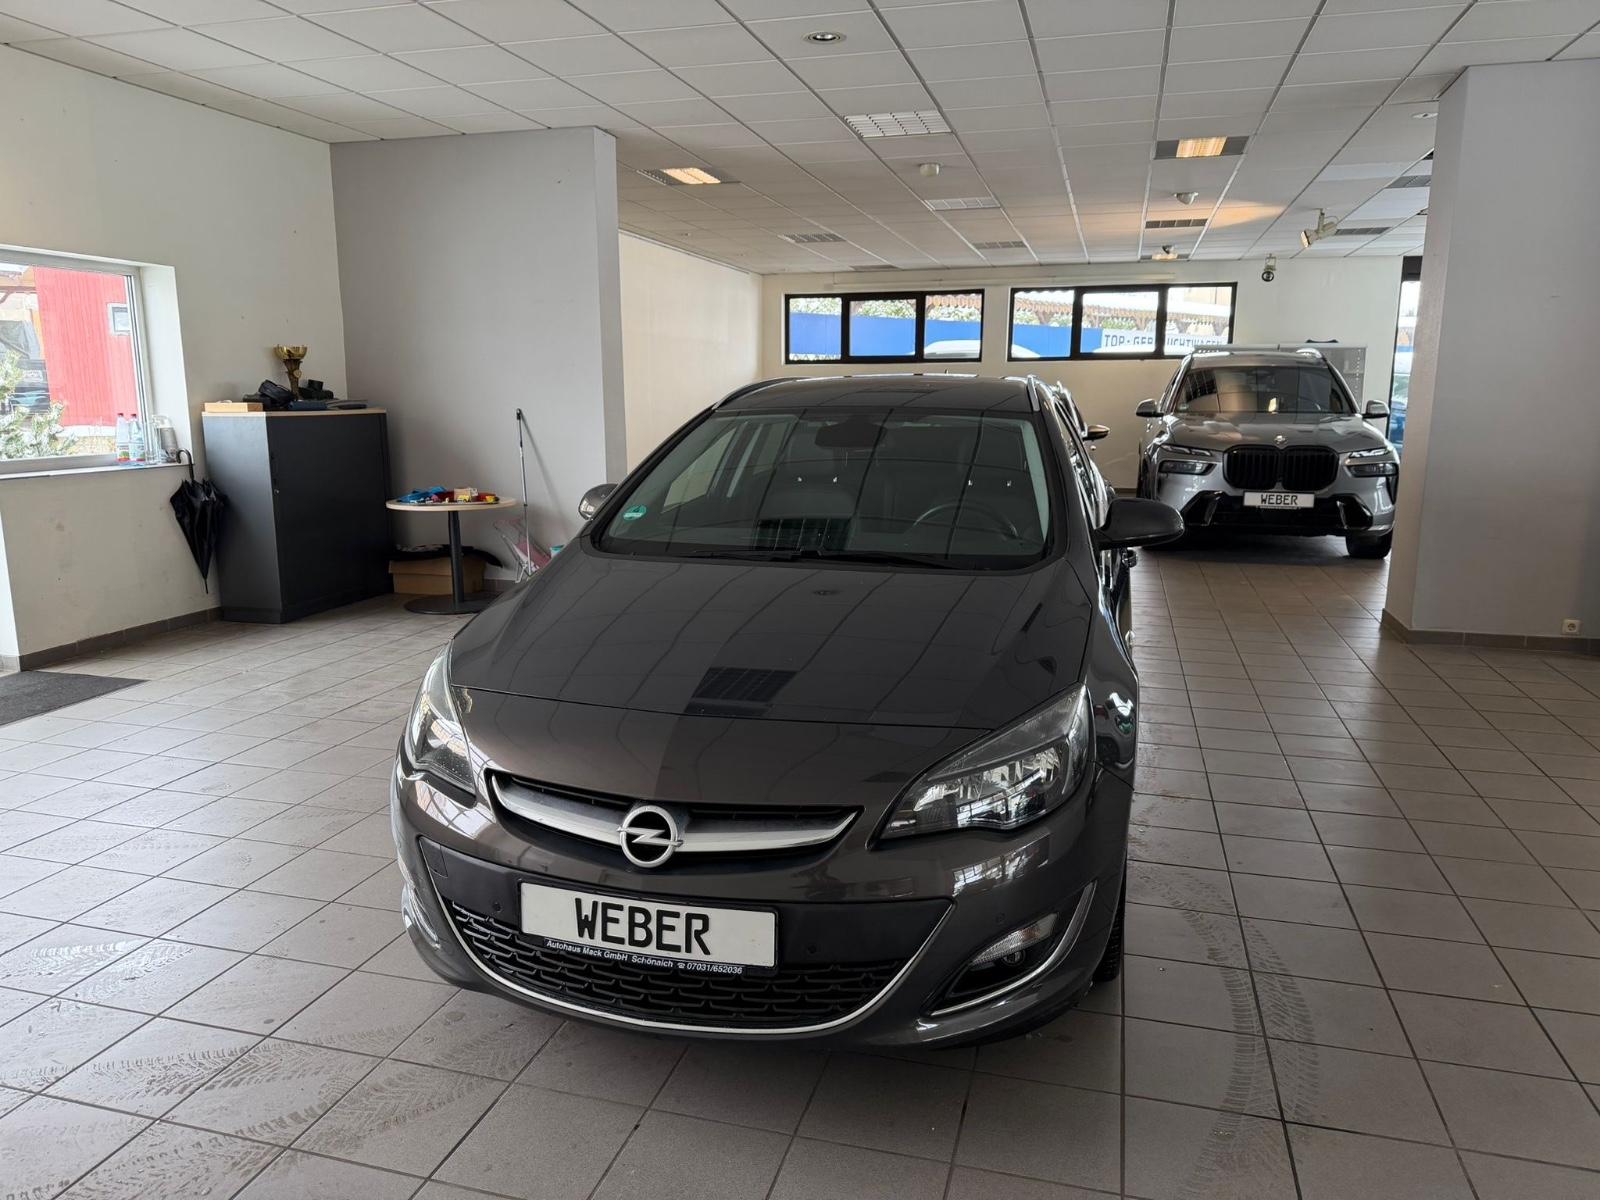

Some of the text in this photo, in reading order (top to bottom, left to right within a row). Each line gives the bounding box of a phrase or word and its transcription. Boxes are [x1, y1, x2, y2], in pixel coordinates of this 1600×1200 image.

[1105, 335, 1125, 347] TOP
[1260, 494, 1298, 505] WEBER
[575, 898, 711, 955] WEBER
[546, 940, 743, 974] Autohaus Mack GmbH Schönaich 07031/652036
